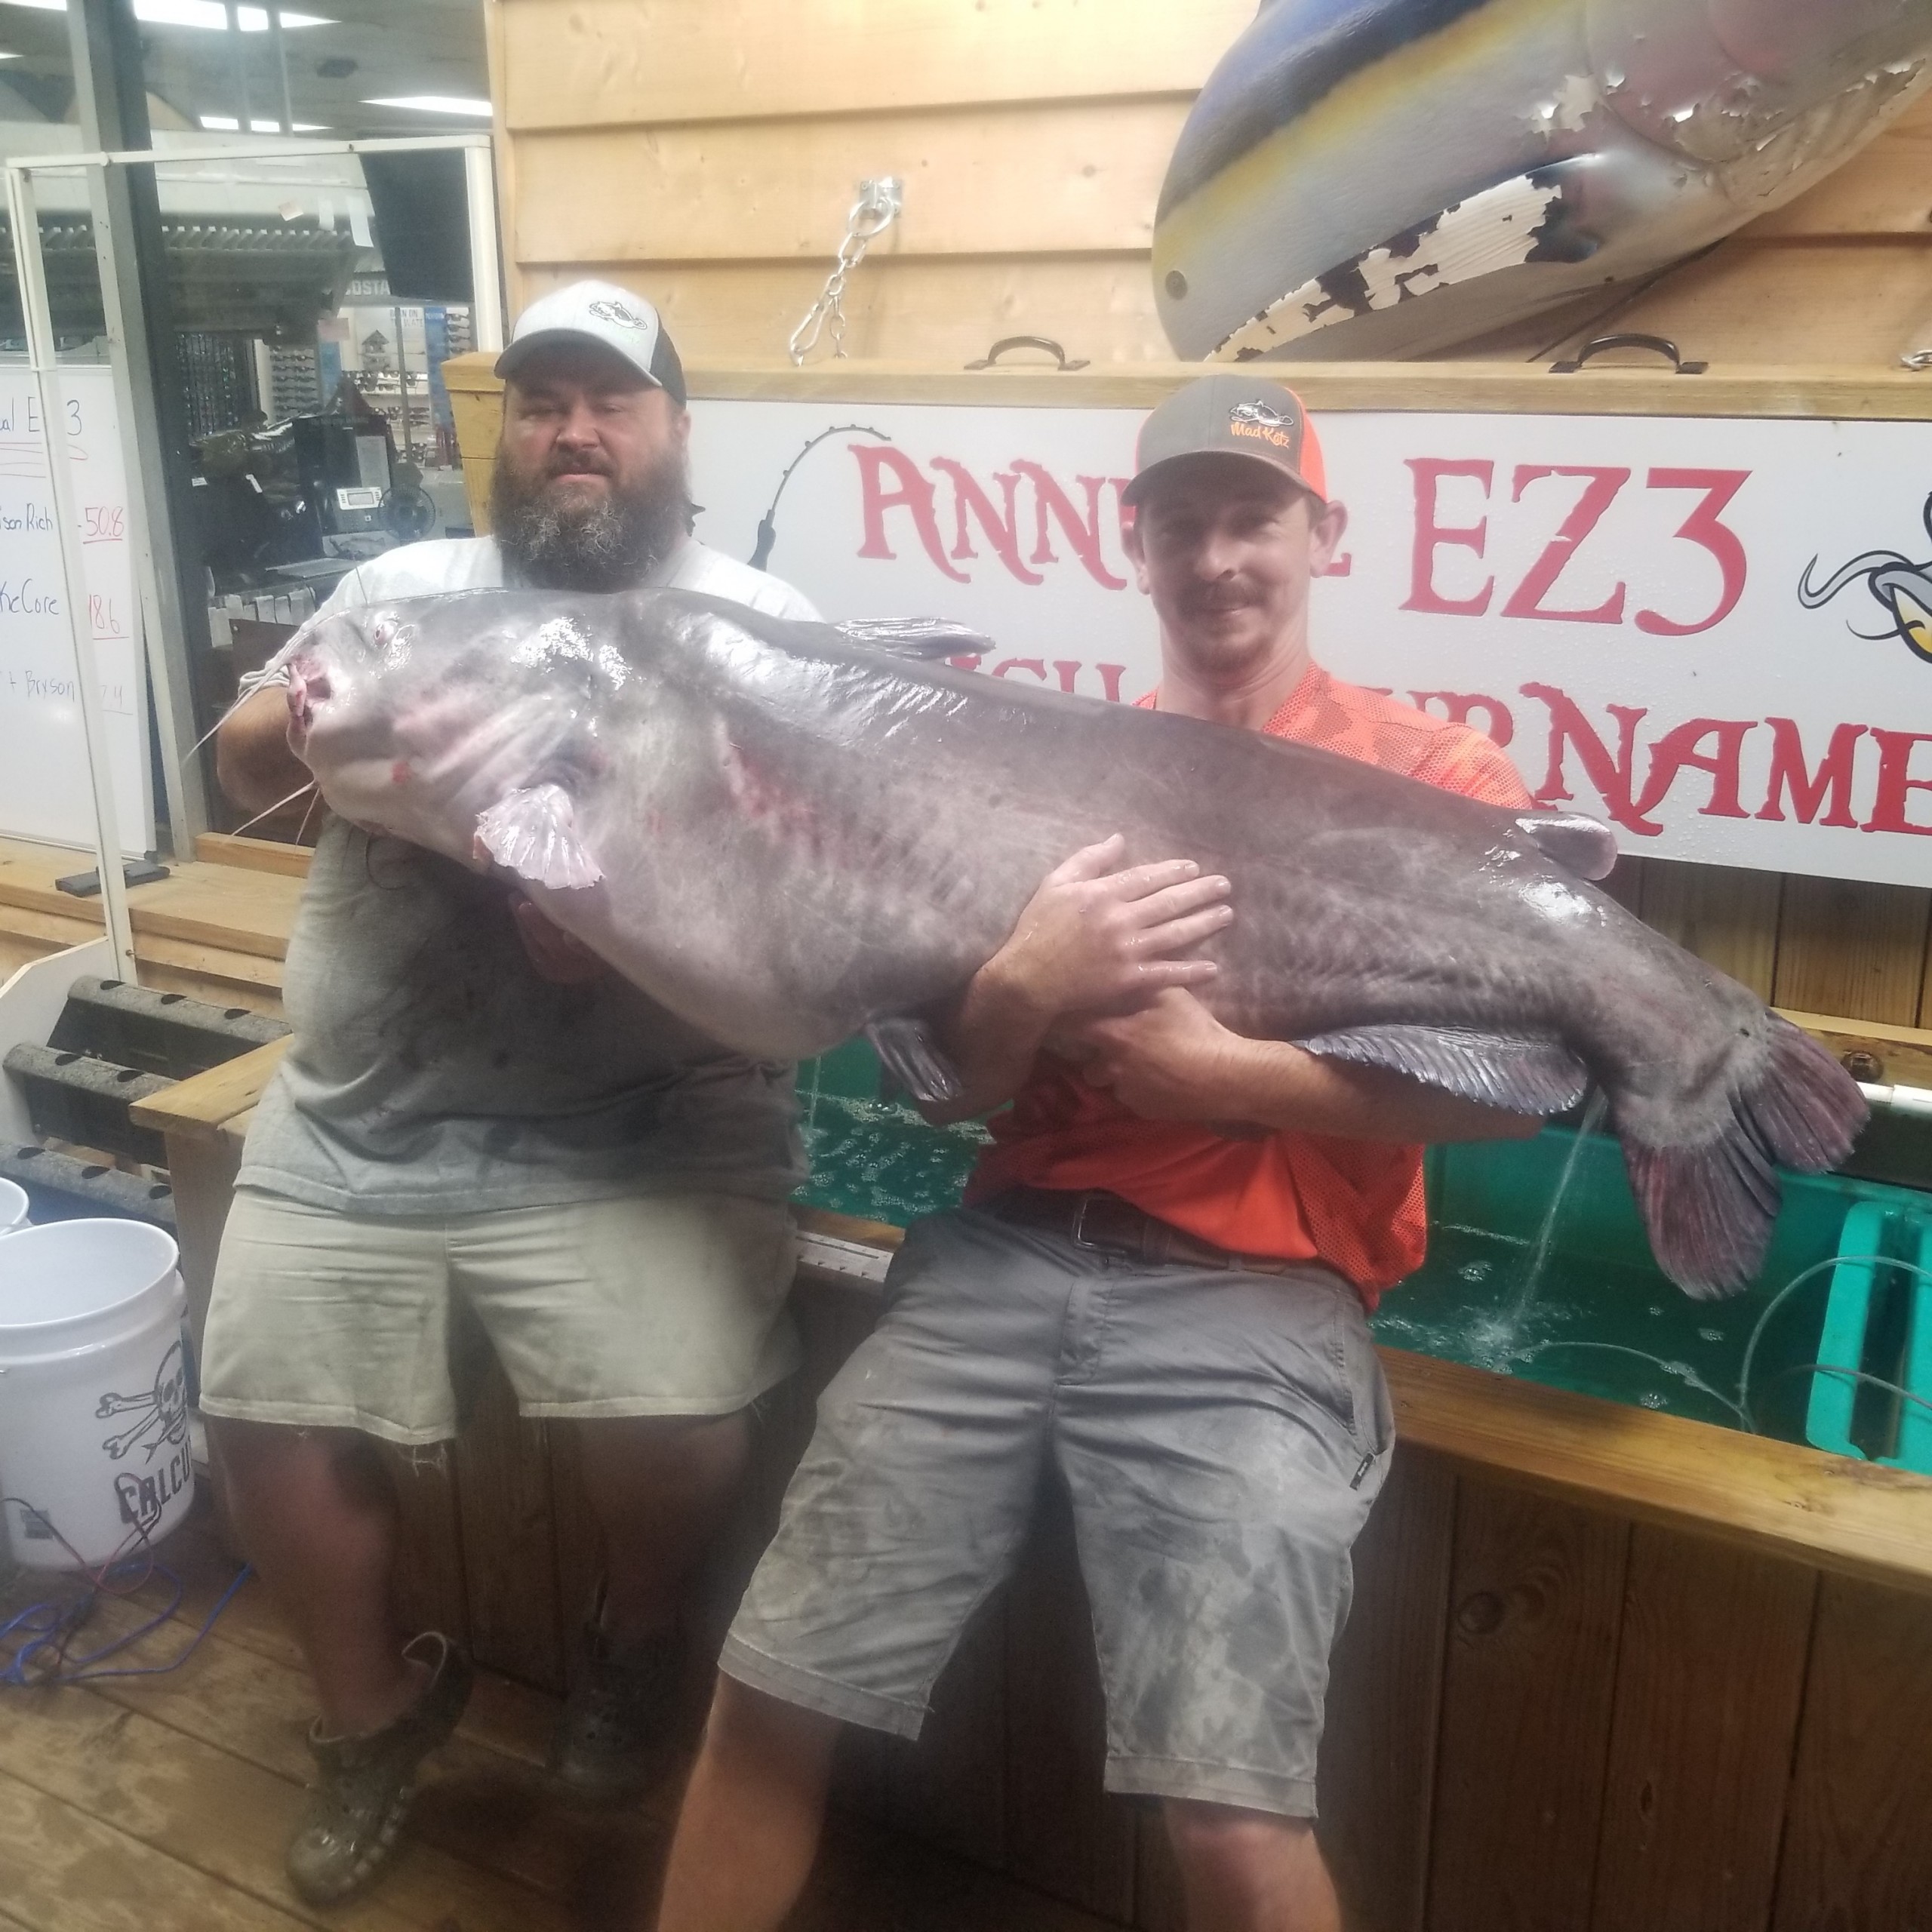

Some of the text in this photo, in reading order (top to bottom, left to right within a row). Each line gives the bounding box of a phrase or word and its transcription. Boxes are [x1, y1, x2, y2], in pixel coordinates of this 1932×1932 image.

[345, 279, 391, 295] OSTA
[0, 397, 14, 432] al
[1231, 421, 1261, 438] Mad
[0, 504, 22, 531] son
[26, 502, 54, 532] Rich
[1398, 457, 1753, 636] EZ3
[26, 669, 75, 703] Bryson
